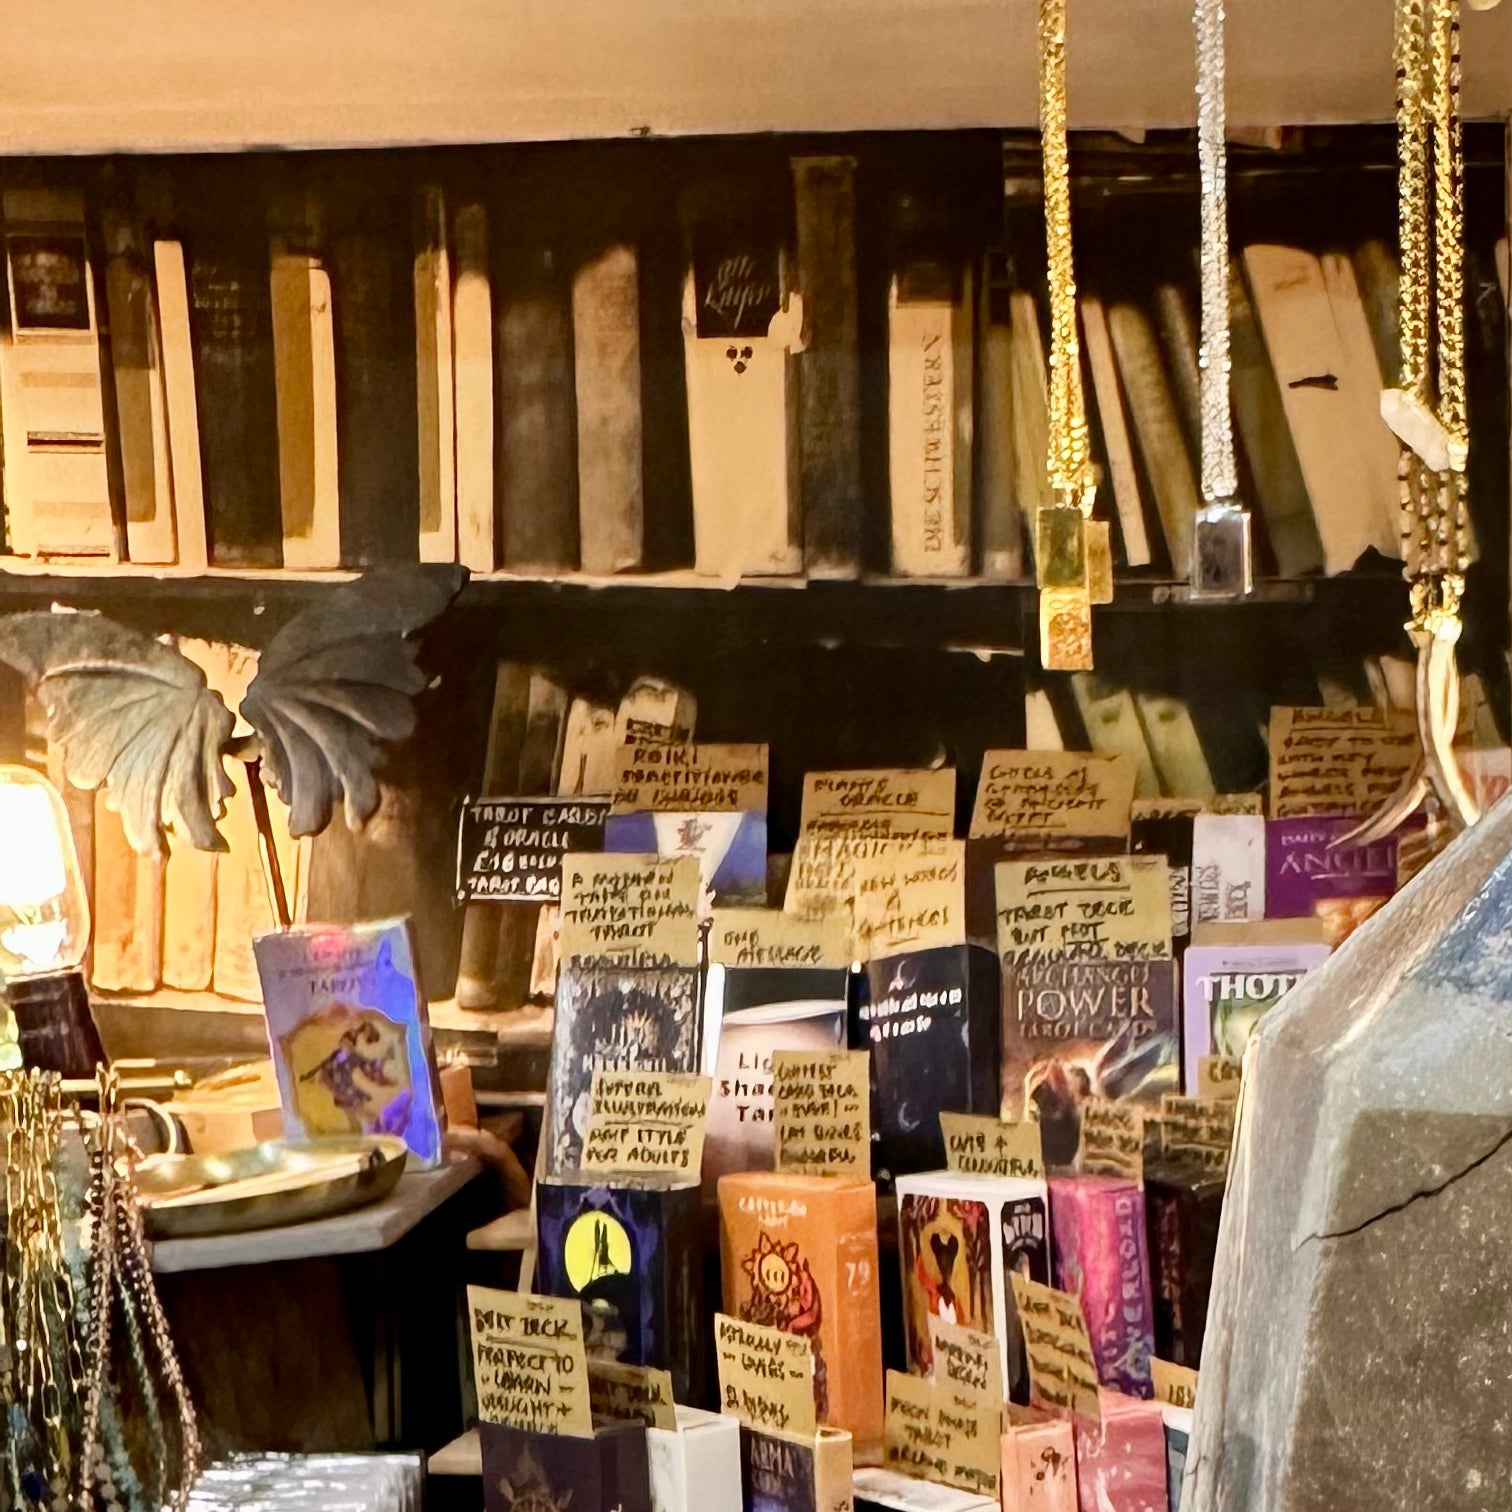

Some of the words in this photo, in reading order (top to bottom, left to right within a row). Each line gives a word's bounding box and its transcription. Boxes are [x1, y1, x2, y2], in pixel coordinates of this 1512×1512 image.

[468, 805, 534, 826] TAROT
[467, 876, 521, 895] TAROT
[1016, 987, 1155, 1022] POWER
